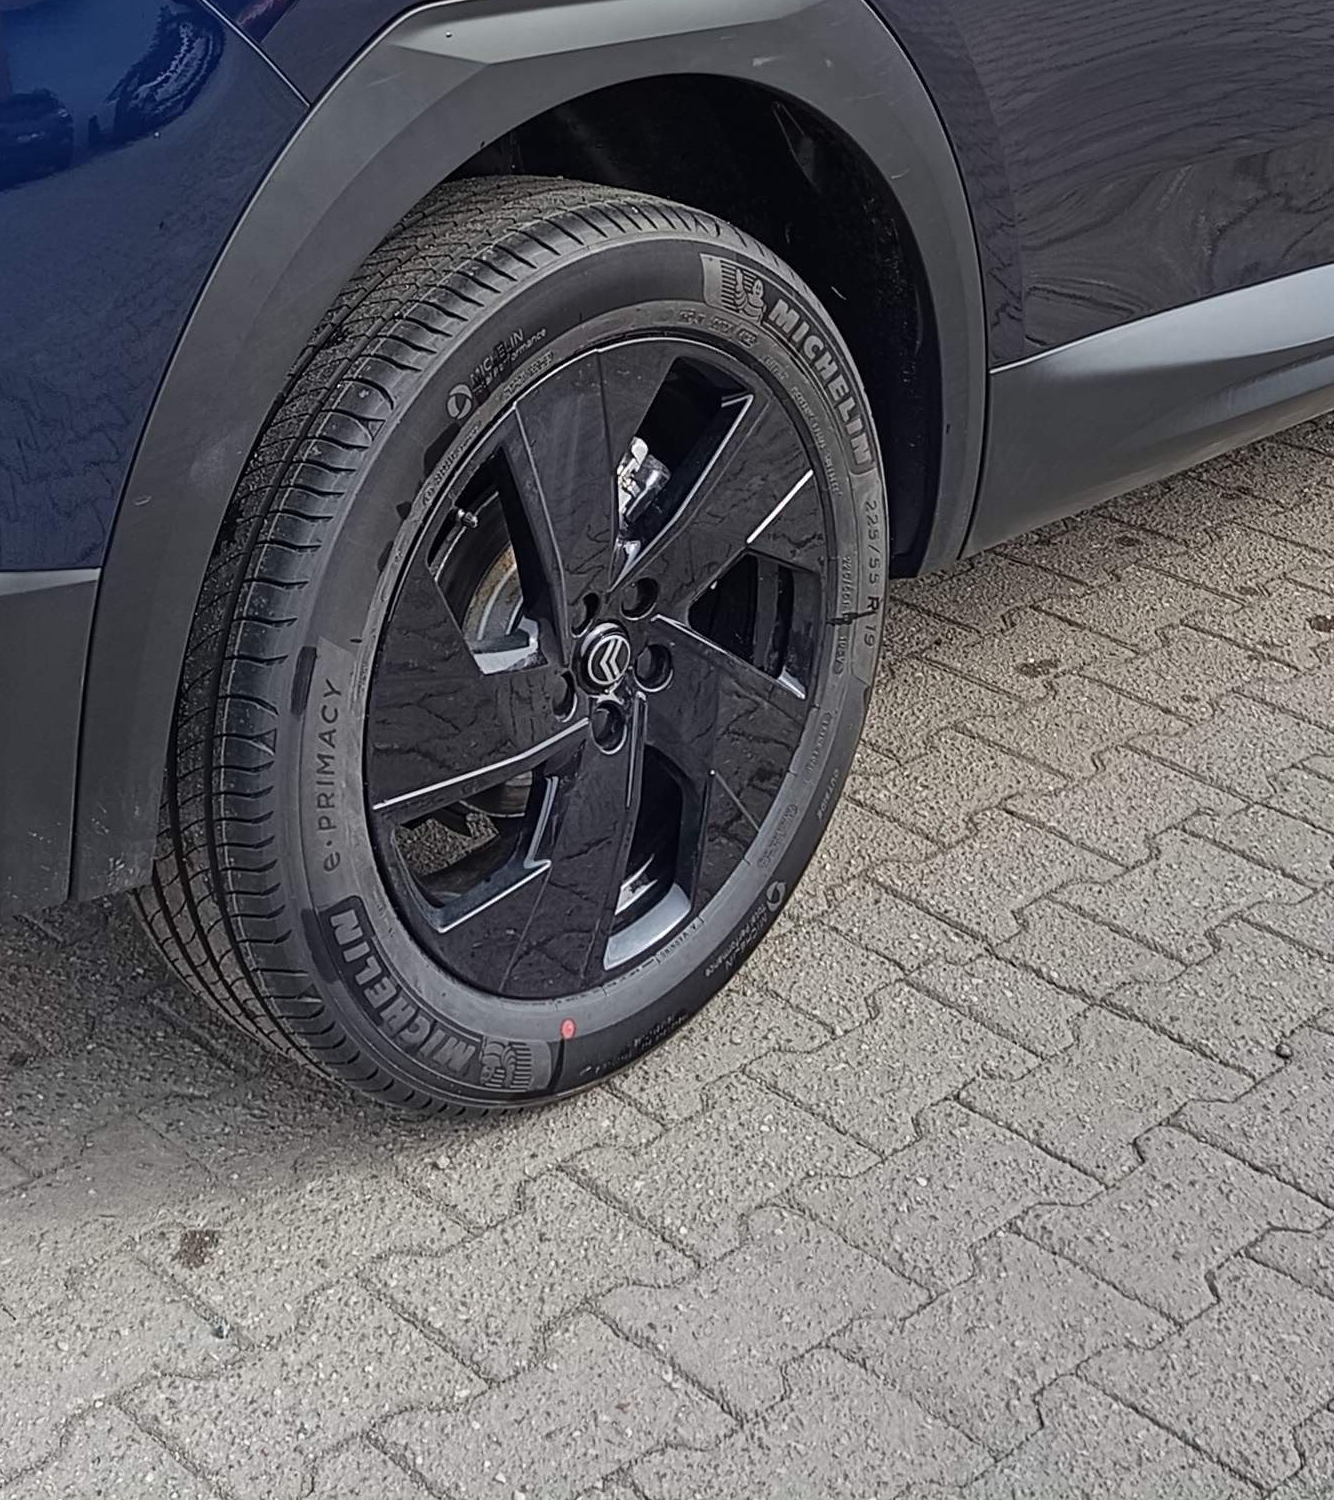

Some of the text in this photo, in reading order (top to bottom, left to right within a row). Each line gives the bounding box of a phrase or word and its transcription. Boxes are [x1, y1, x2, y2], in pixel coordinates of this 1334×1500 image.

[470, 328, 525, 384] MICHELIN
[767, 298, 872, 466] MICHELIN
[865, 500, 880, 585] 225/55
[329, 908, 477, 1073] MICHELIN
